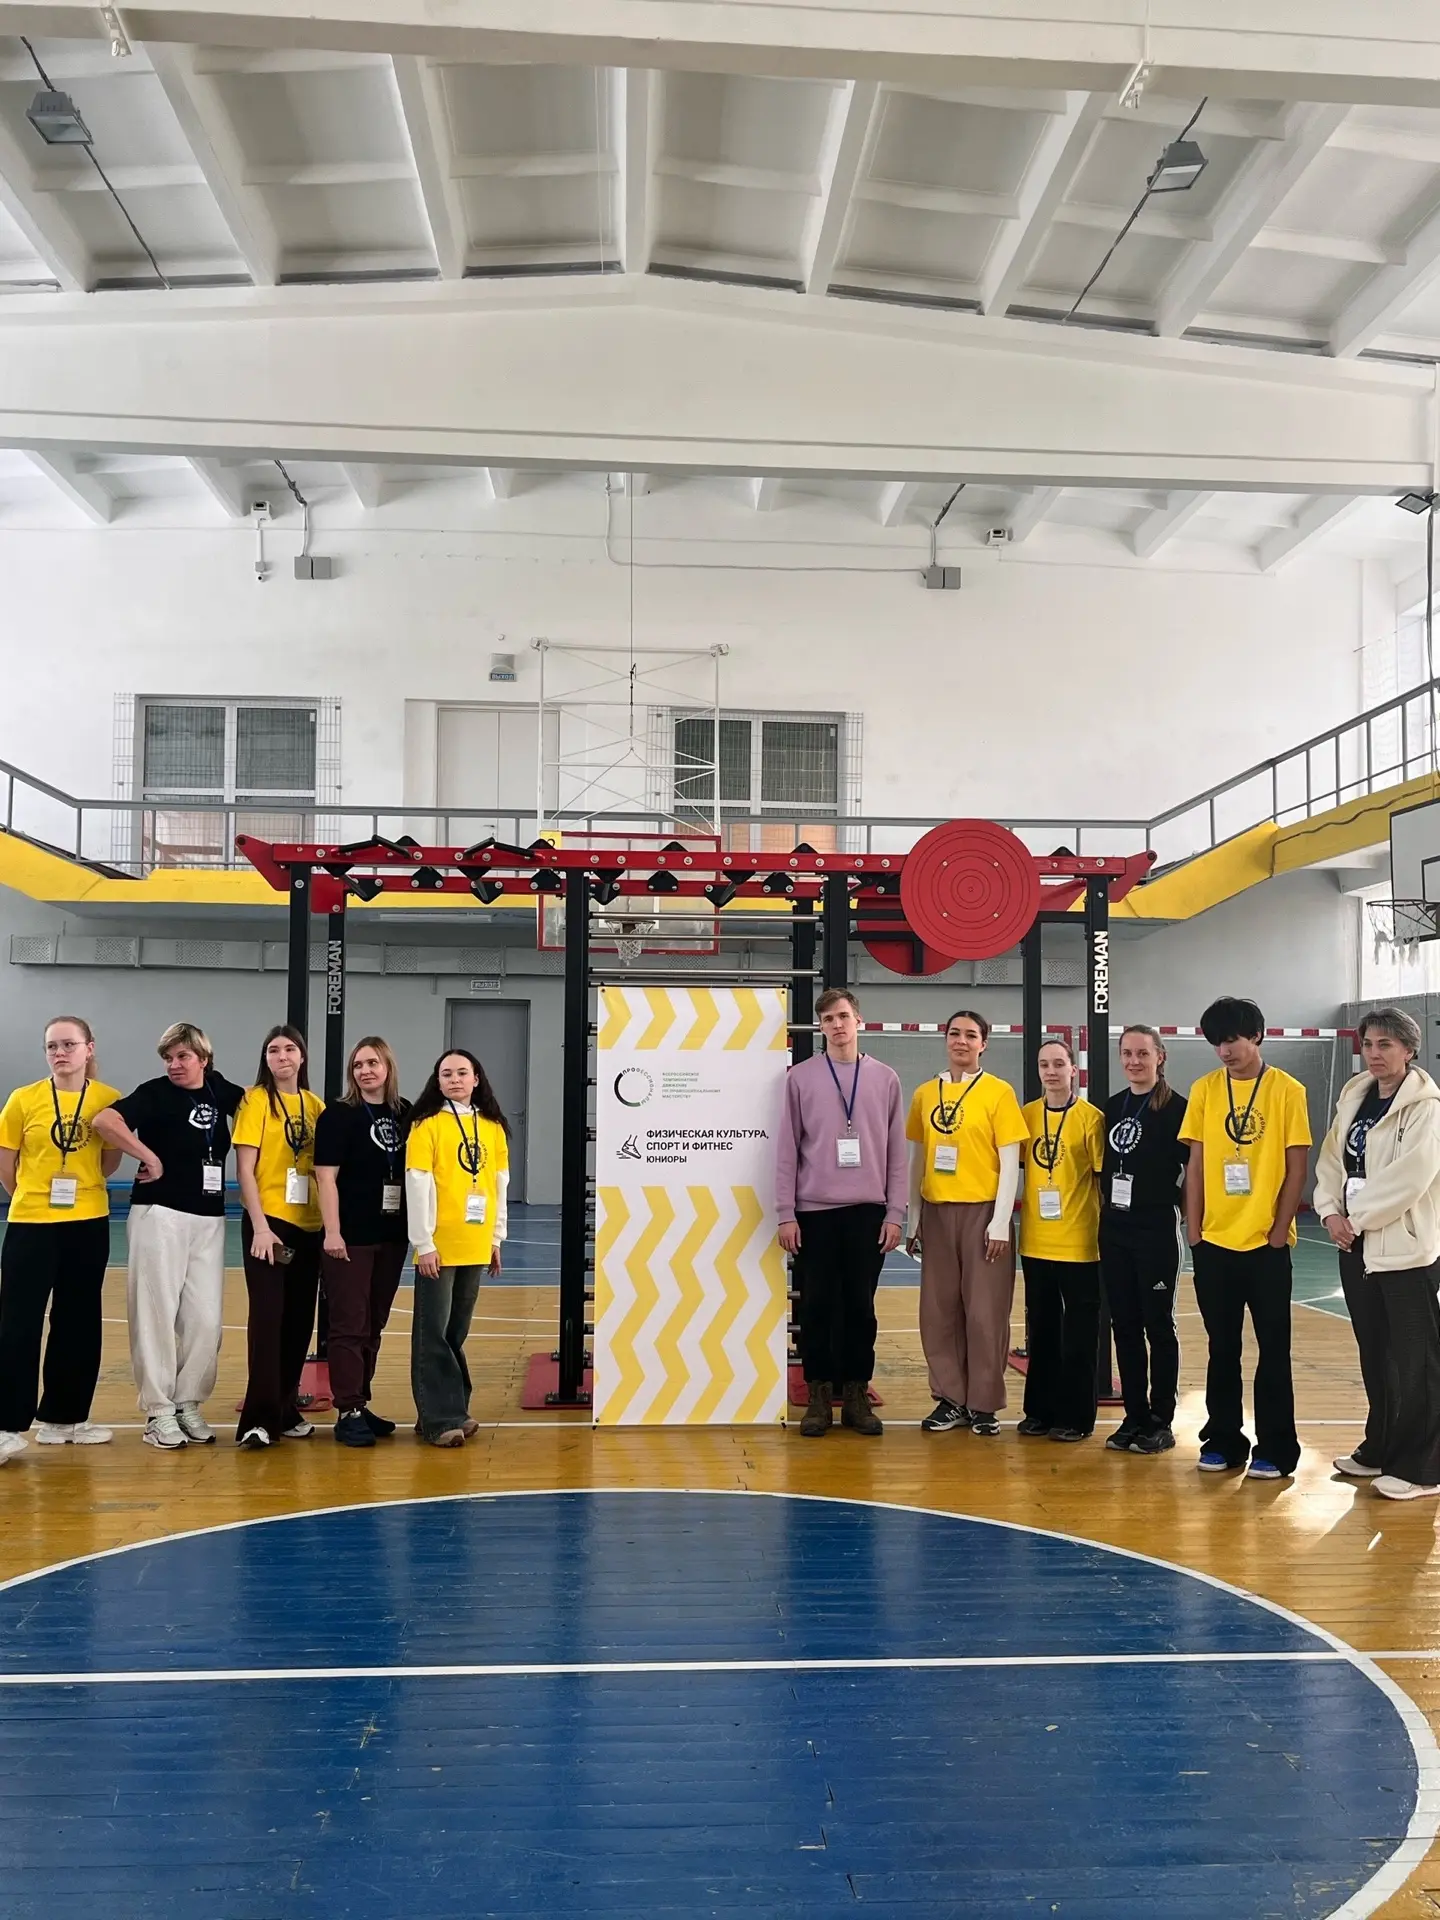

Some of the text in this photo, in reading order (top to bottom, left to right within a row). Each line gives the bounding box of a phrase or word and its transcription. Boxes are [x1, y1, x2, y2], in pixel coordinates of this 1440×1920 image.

[328, 940, 342, 1015] FOREMAN
[1094, 930, 1109, 1014] FOREMAN
[622, 1067, 655, 1105] ПРОФЕССИОНАЛЫ
[646, 1129, 769, 1140] ФИЗИЧЕСКАЯ КУЛЬТУРА,
[1234, 1105, 1266, 1143] ПРОЕССИОНАЛЫ
[646, 1142, 734, 1151] СПОРТ И ФИТНЕС
[646, 1155, 687, 1163] ЮНИОРЫ
